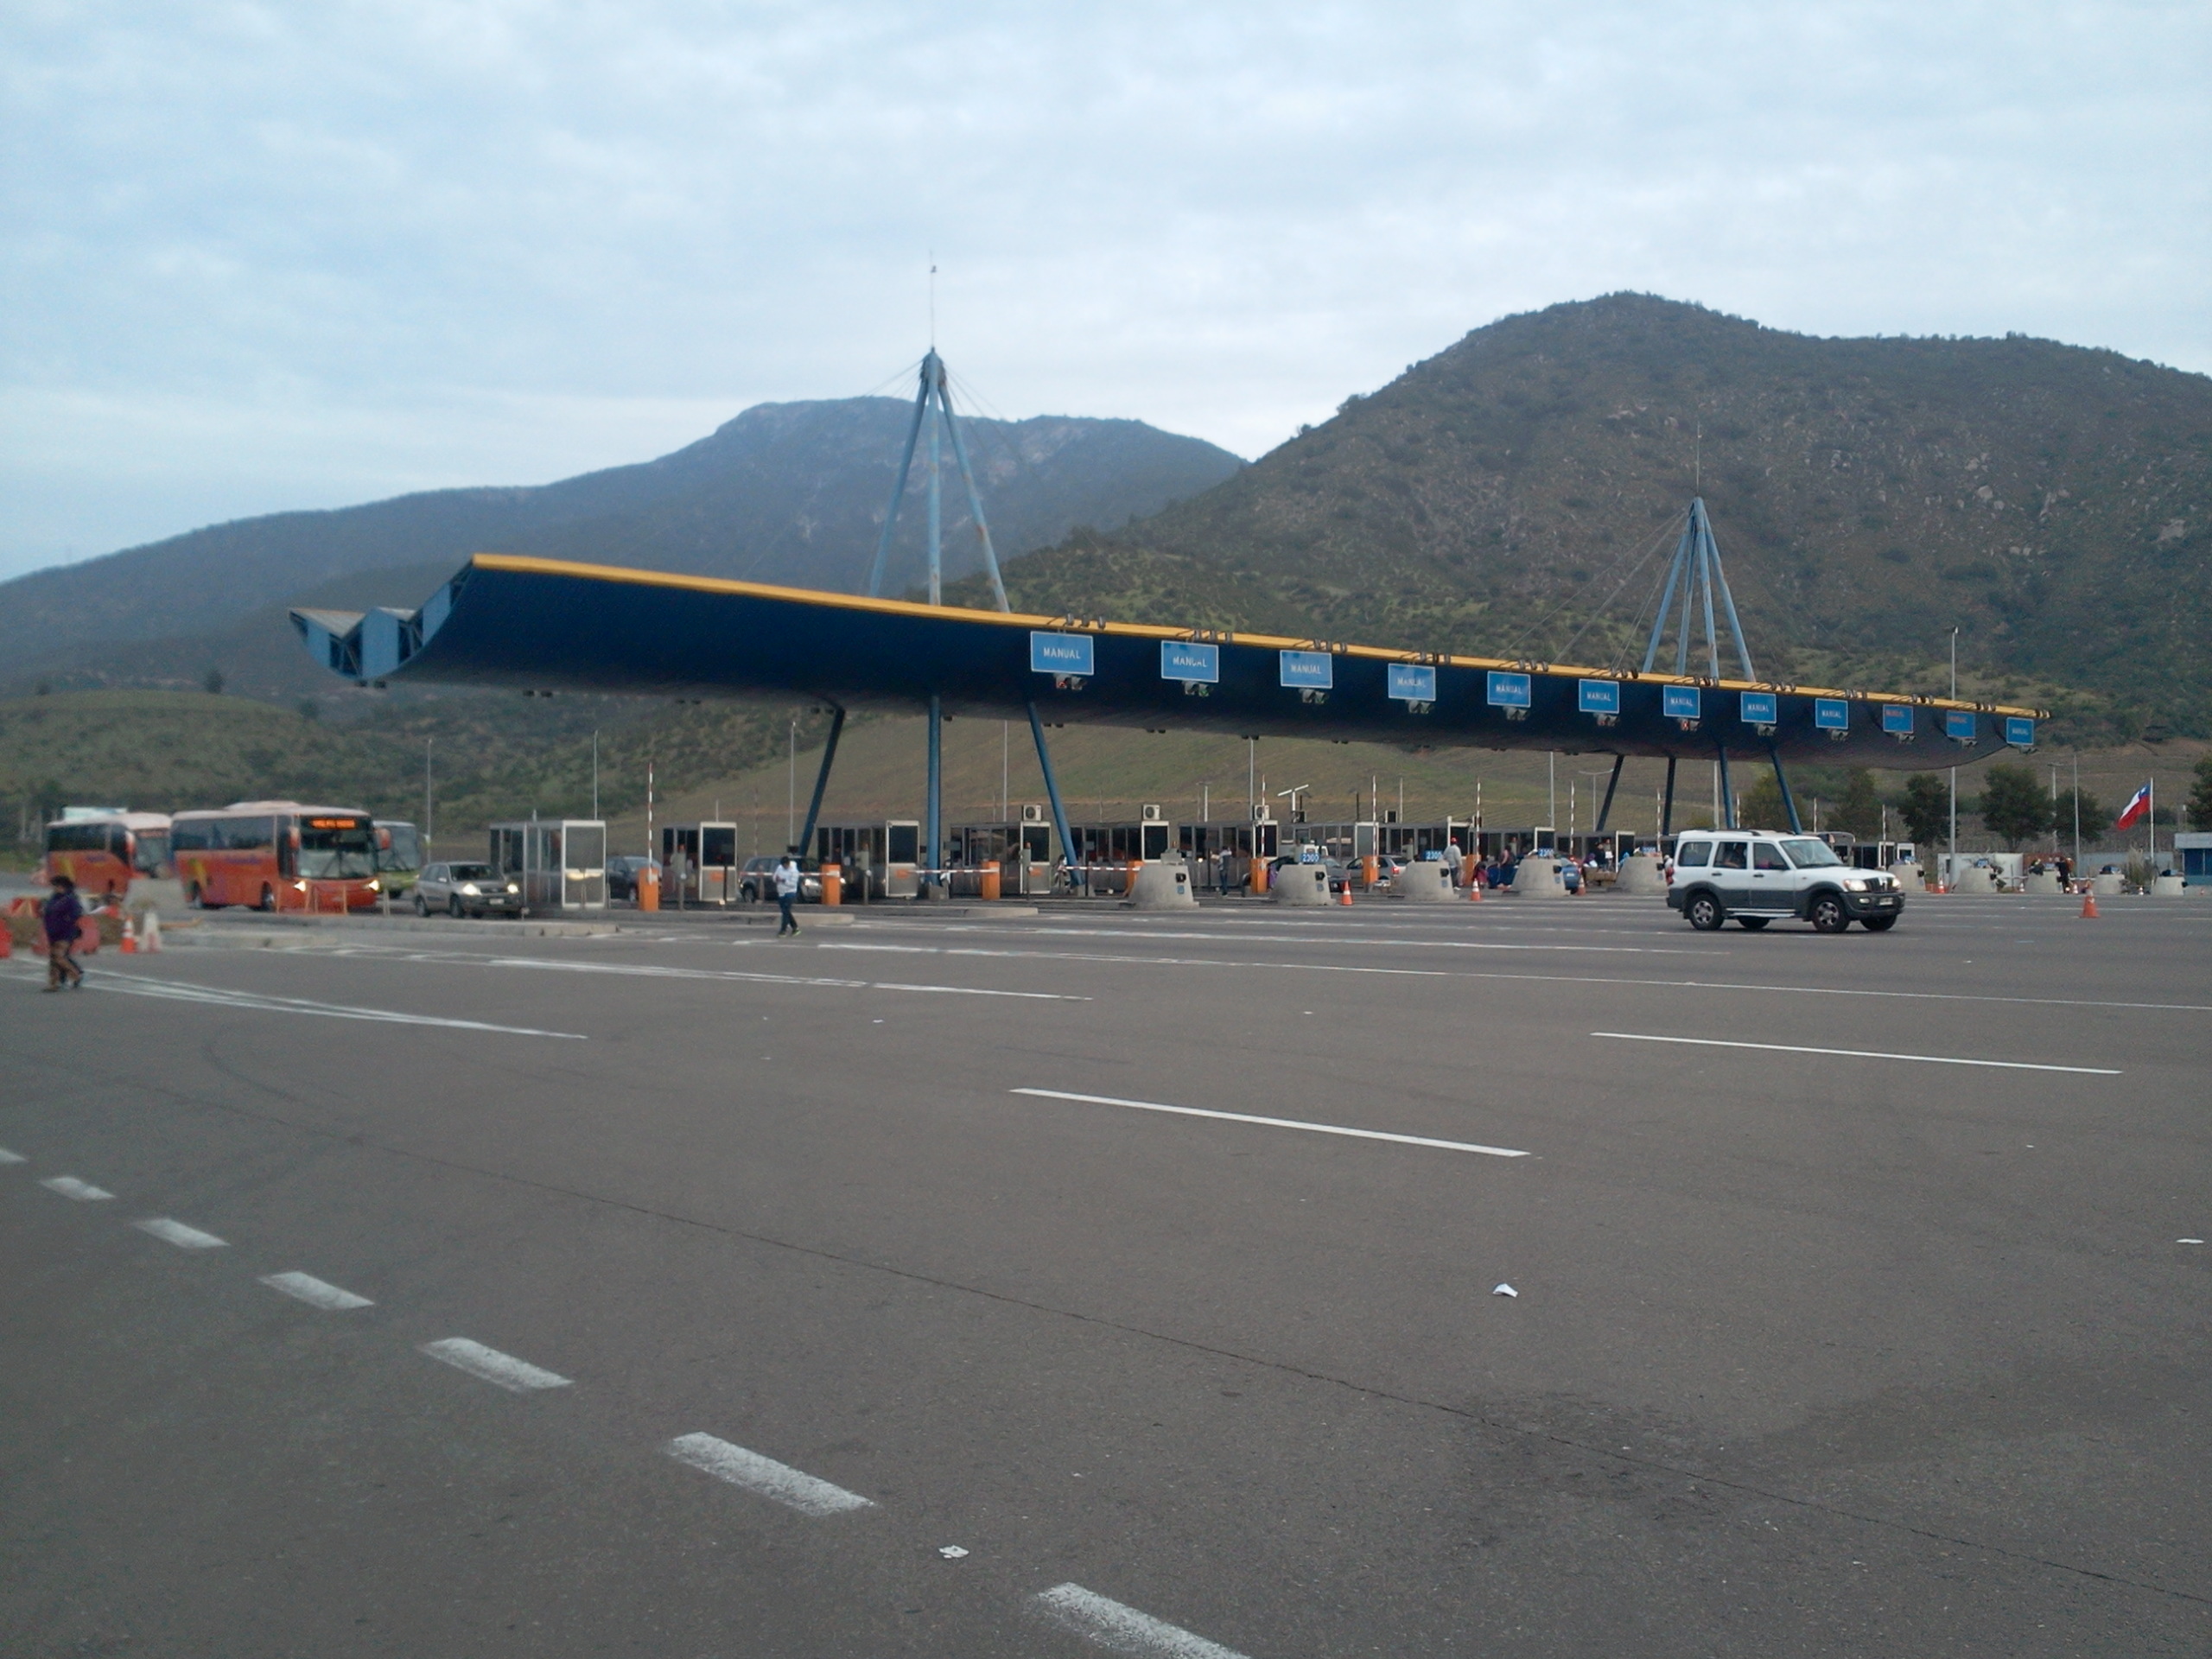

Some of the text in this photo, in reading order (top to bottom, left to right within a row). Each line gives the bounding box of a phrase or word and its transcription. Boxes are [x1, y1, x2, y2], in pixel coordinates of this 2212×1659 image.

[1043, 647, 1081, 659] MANUAL
[1173, 656, 1207, 668] MANUAL
[1290, 664, 1322, 674] MANUAL
[1397, 677, 1427, 688] MANUAL
[1496, 684, 1522, 695] MANUAL
[1586, 691, 1611, 702] MANUAL
[1670, 697, 1693, 707] MANUAL
[1747, 703, 1769, 712] MANUAL
[1302, 853, 1319, 862] 2300
